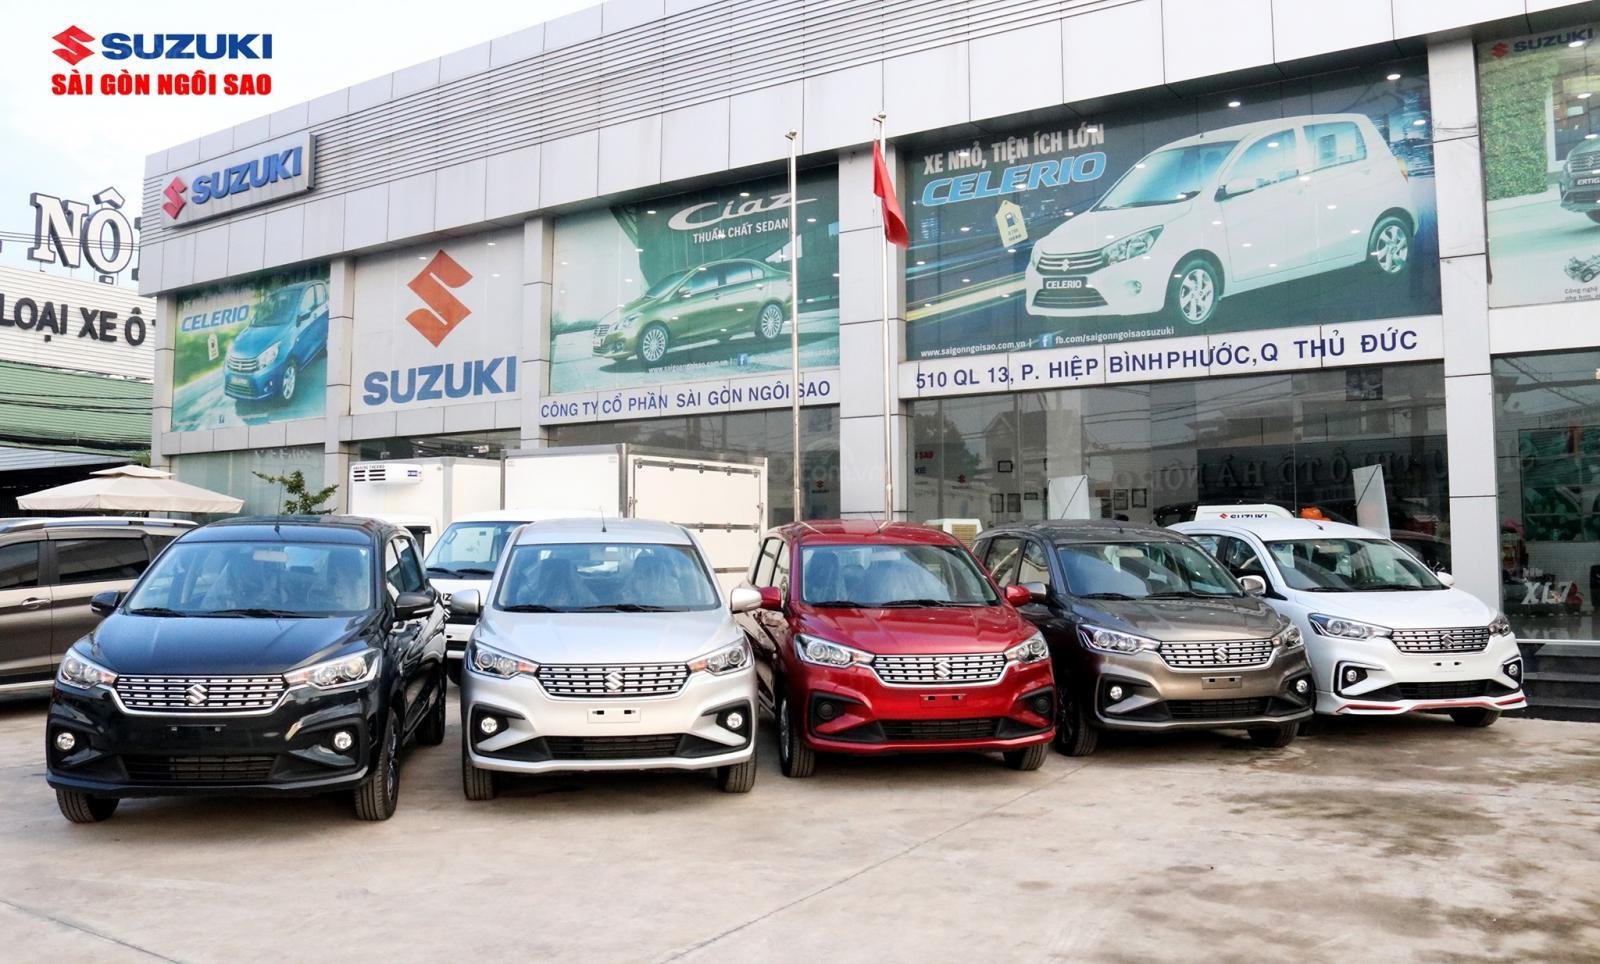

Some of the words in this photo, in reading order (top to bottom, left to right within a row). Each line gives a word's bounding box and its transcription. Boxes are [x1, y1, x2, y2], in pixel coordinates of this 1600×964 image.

[1513, 28, 1593, 52] SUZUKI
[923, 152, 944, 176] XE
[947, 140, 987, 170] NHỎ,
[991, 136, 1028, 164] TIỆN
[1033, 130, 1062, 156] ÍCH
[191, 145, 303, 205] SUZUKI
[922, 151, 1107, 206] CELERIO
[668, 192, 818, 231] Ciaz
[728, 221, 753, 238] CHẤT
[756, 217, 789, 234] SEDAN
[27, 186, 141, 285] NỘ
[1046, 280, 1082, 289] CELERIO
[0, 293, 68, 342] LOẠI
[78, 307, 117, 342] XE
[125, 306, 147, 346] Ô
[181, 304, 250, 332] CELERIO
[916, 371, 947, 389] 510
[954, 369, 980, 386] QL
[988, 366, 1014, 384] 13,
[1021, 364, 1040, 381] P.
[1050, 355, 1099, 381] HIỆP
[1293, 329, 1346, 359] THỦ
[1360, 326, 1418, 353] ĐỨC
[920, 339, 1026, 357] www.saigonngoisao.com.vn
[363, 356, 518, 406] SUZUKI
[541, 400, 578, 418] CÔNG
[582, 400, 599, 416] TY
[602, 392, 622, 414] CỔ
[629, 391, 668, 412] PHẦN
[676, 388, 701, 408] SÀI
[708, 385, 743, 406] GÒN
[748, 380, 789, 401] NGÔI
